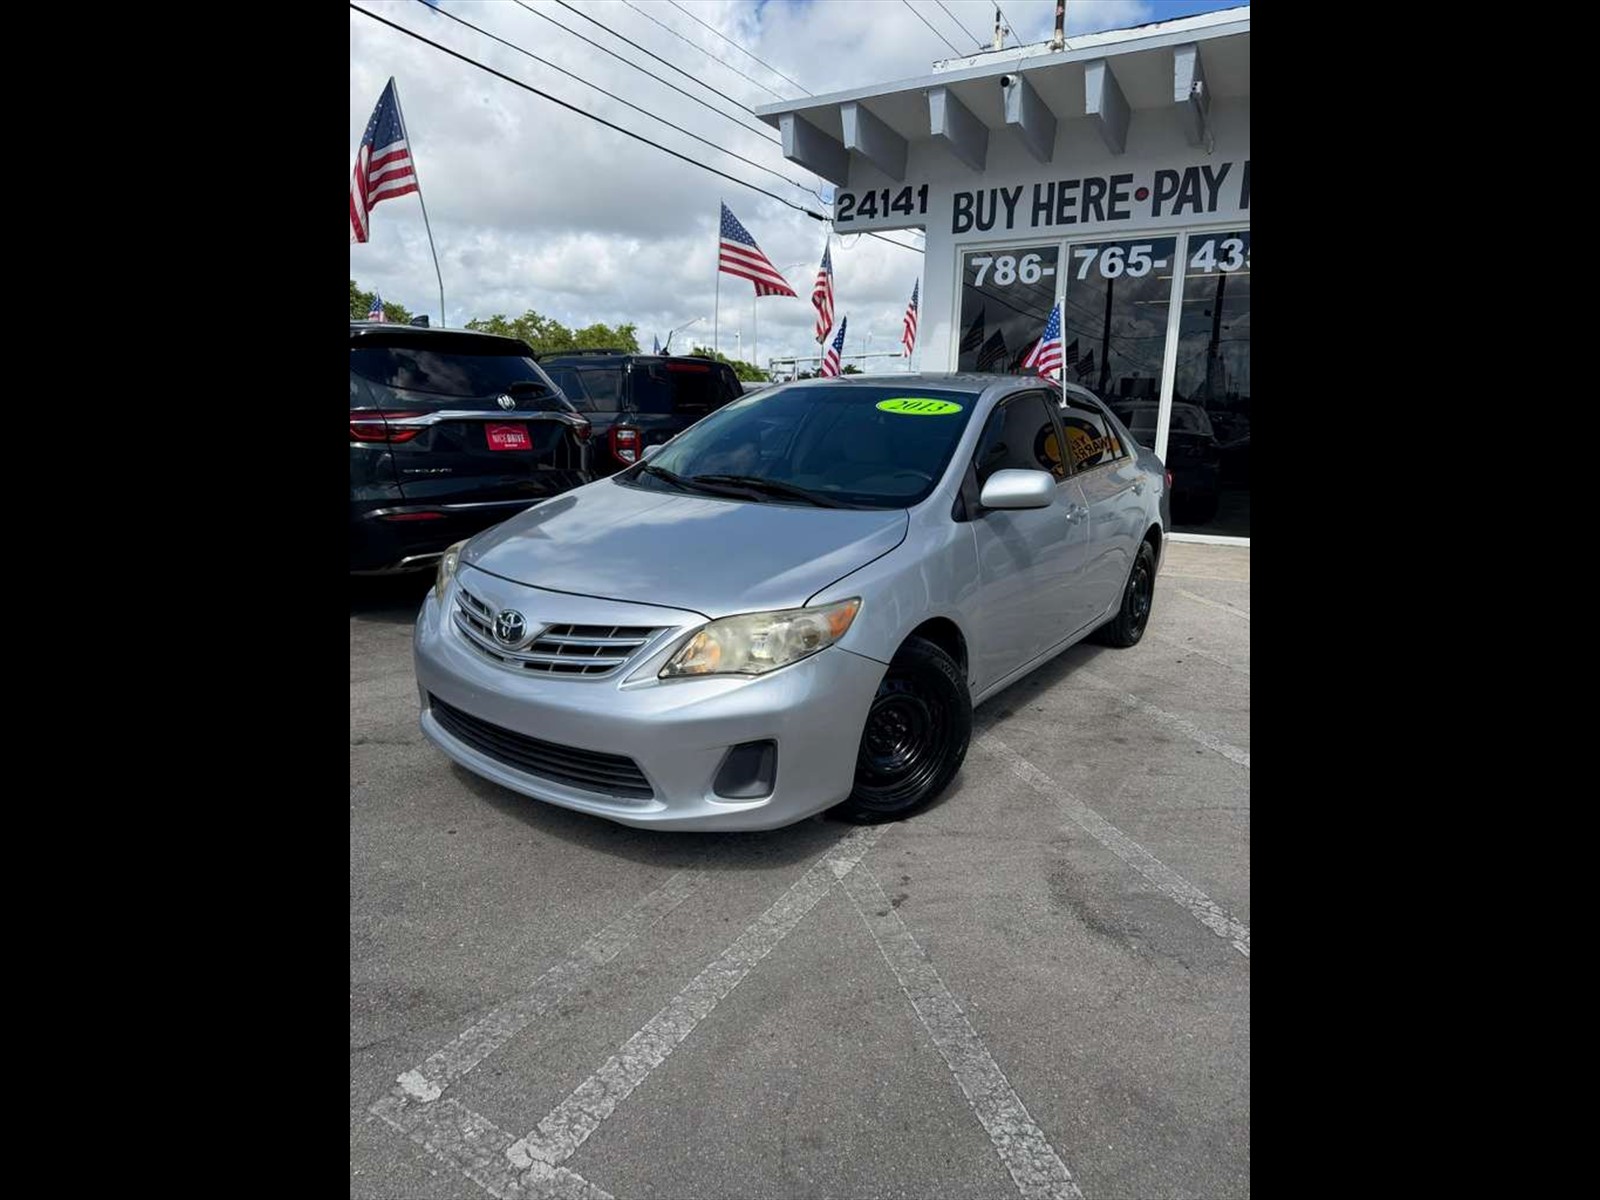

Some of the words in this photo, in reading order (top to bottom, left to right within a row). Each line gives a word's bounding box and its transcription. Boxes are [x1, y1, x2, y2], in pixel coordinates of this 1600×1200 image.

[837, 184, 929, 222] 24141
[952, 185, 1024, 234] BUY
[1031, 173, 1134, 227] HERE
[1151, 162, 1233, 217] PAY
[971, 253, 1055, 287] 786-
[1074, 245, 1168, 280] 765-
[1190, 238, 1250, 273] 43
[886, 401, 950, 412] 2013
